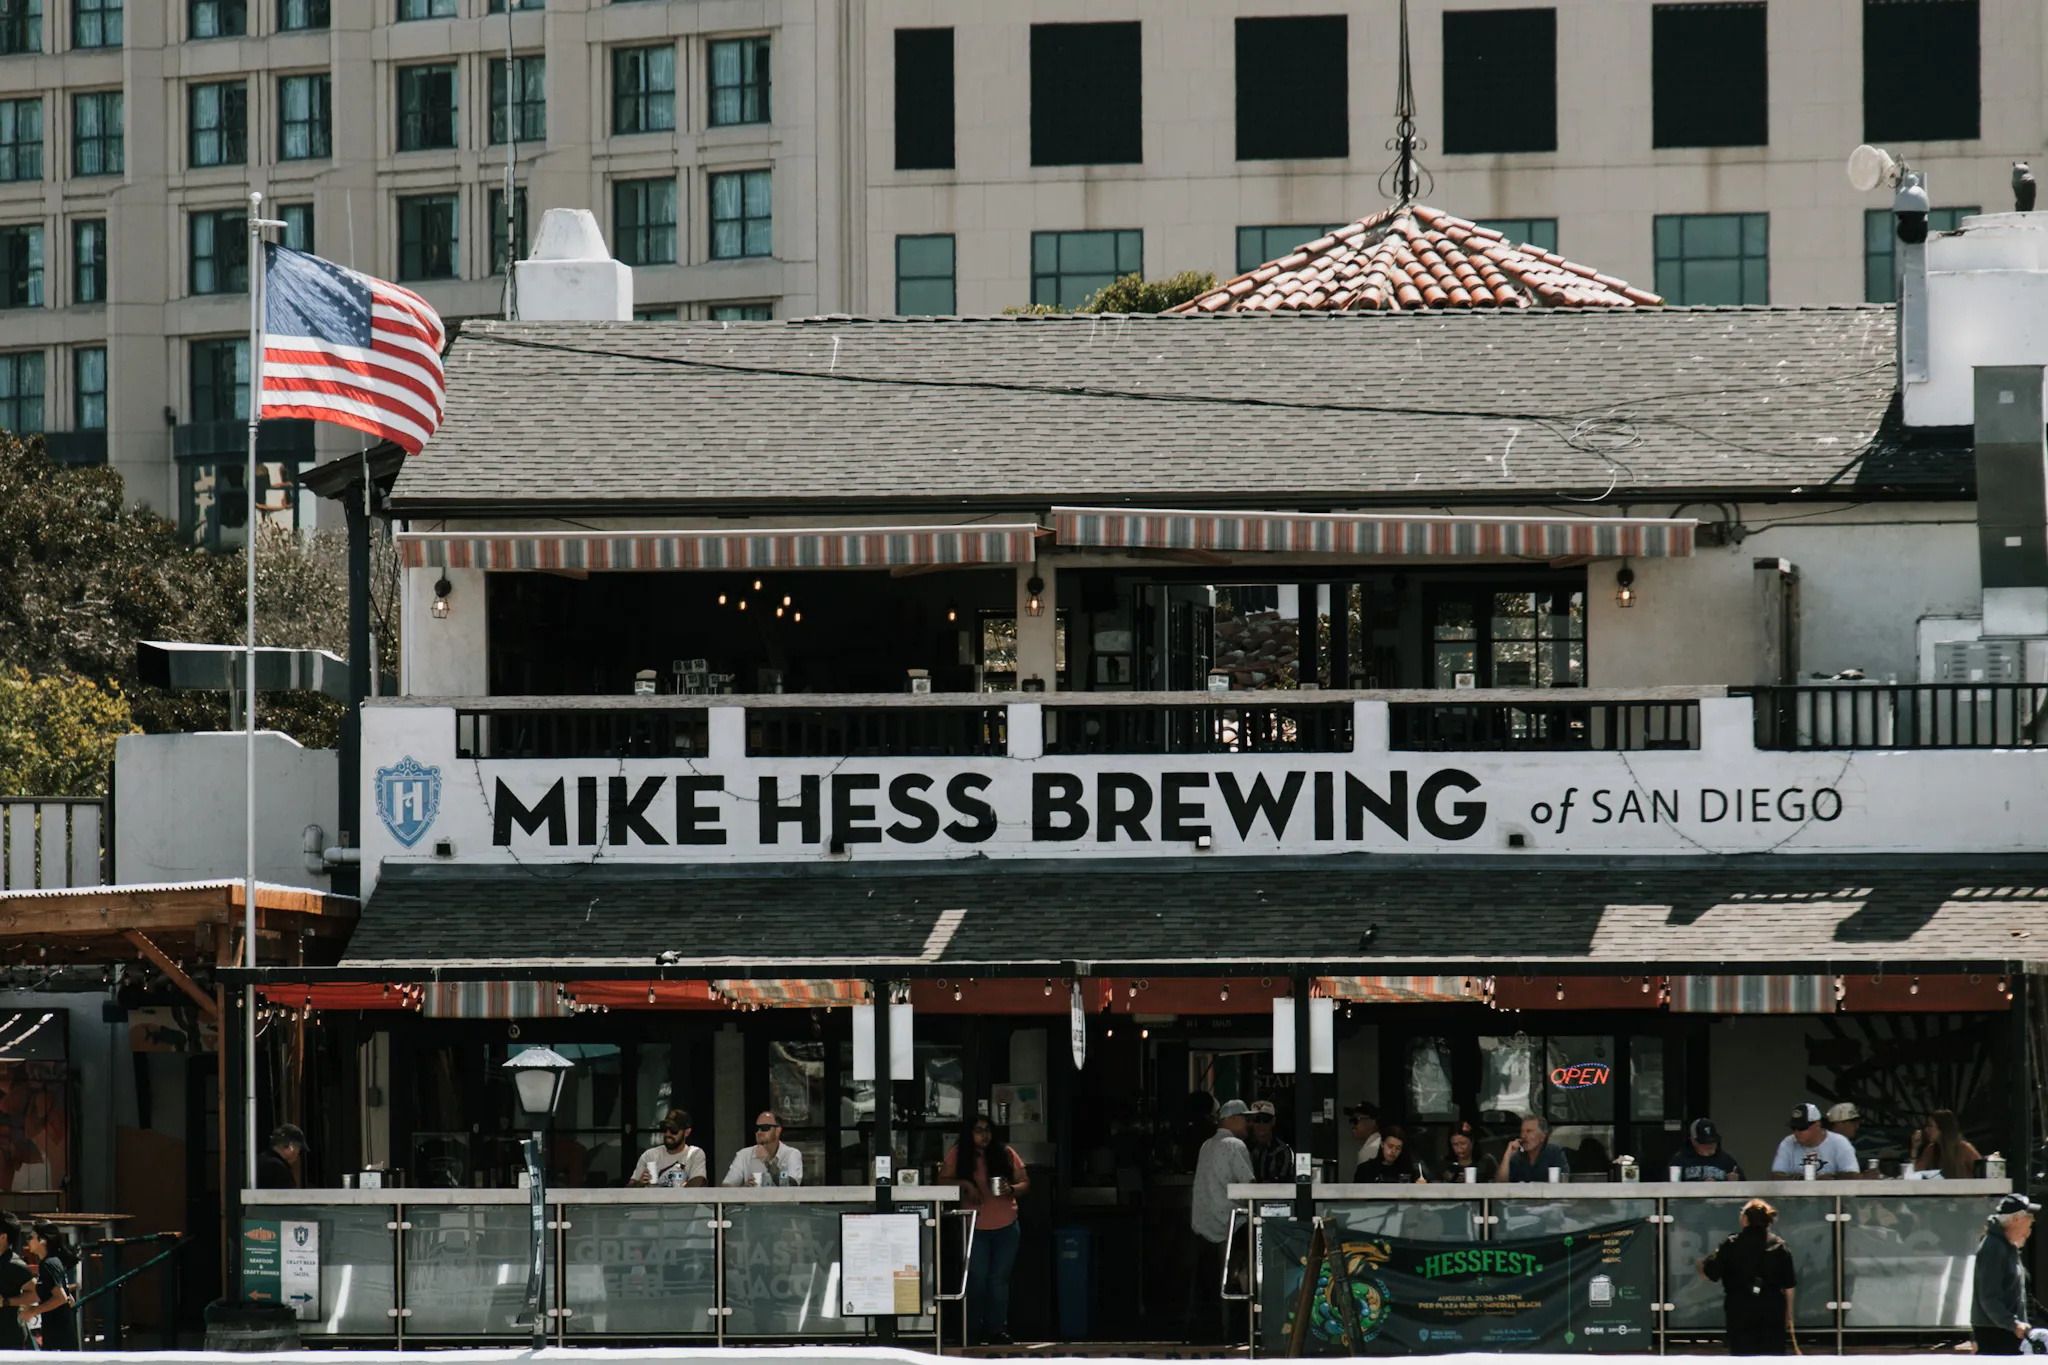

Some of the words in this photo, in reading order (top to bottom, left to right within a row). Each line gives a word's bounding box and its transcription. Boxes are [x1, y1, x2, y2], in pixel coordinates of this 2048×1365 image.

[491, 775, 727, 846] MIKE
[758, 772, 998, 844] HESS
[1031, 768, 1488, 842] BREWING
[1531, 787, 1577, 834] of
[1592, 789, 1679, 823] SAN
[1700, 787, 1842, 822] DIEGO
[1550, 1067, 1610, 1085] OPEN
[574, 1240, 677, 1266] GREAT
[727, 1241, 835, 1266] TASTY
[1425, 1250, 1536, 1280] HESSFEST
